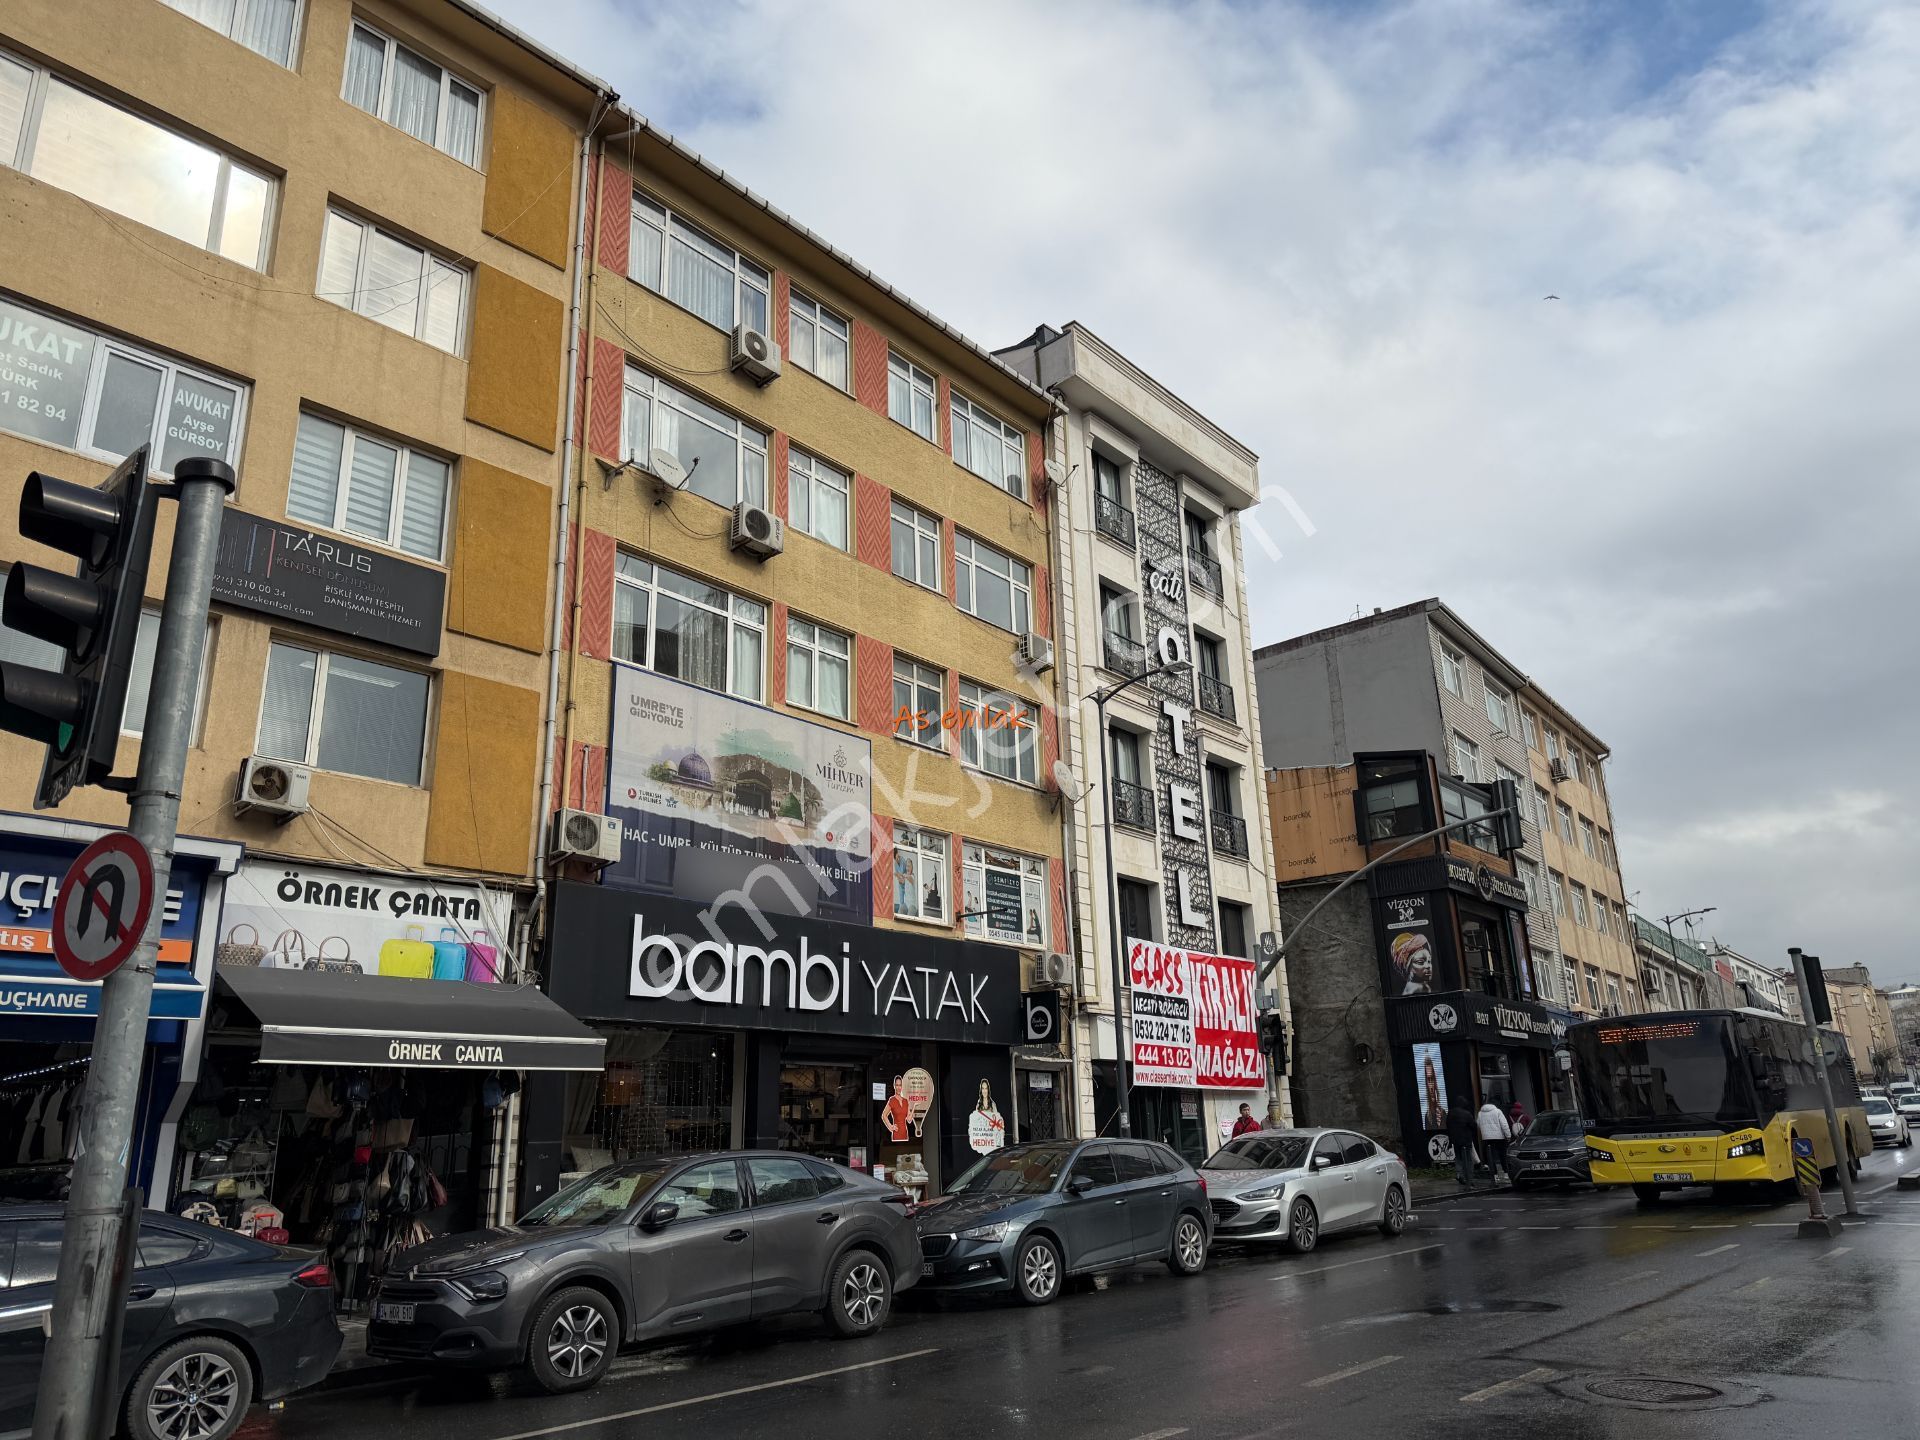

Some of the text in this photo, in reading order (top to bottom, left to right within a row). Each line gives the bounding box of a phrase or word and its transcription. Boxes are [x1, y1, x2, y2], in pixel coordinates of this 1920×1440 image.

[0, 367, 39, 390] ÜRK
[17, 356, 64, 380] Sadık
[17, 395, 40, 413] 82
[45, 404, 67, 421] 94
[174, 388, 230, 420] AVUKAT
[183, 414, 215, 433] Ayşe
[168, 427, 224, 451] GÜRSOY
[258, 583, 272, 594] 00
[273, 588, 286, 598] 34
[815, 761, 864, 788] MİHVER
[624, 827, 649, 844] HAC
[834, 866, 862, 884] BİLETİ
[277, 870, 481, 921] ÖRNEK ÇANTA
[630, 914, 991, 1025] bambi YATAK
[1130, 943, 1184, 995] CLASS
[1493, 1003, 1532, 1032] VİZYON
[1134, 1019, 1155, 1040] 0532
[1155, 1021, 1170, 1042] 224
[1181, 1024, 1191, 1044] 15
[388, 1039, 504, 1064] ÖRNEK ÇANTA
[1138, 1038, 1265, 1079] 444 13 02 MAĞAZA
